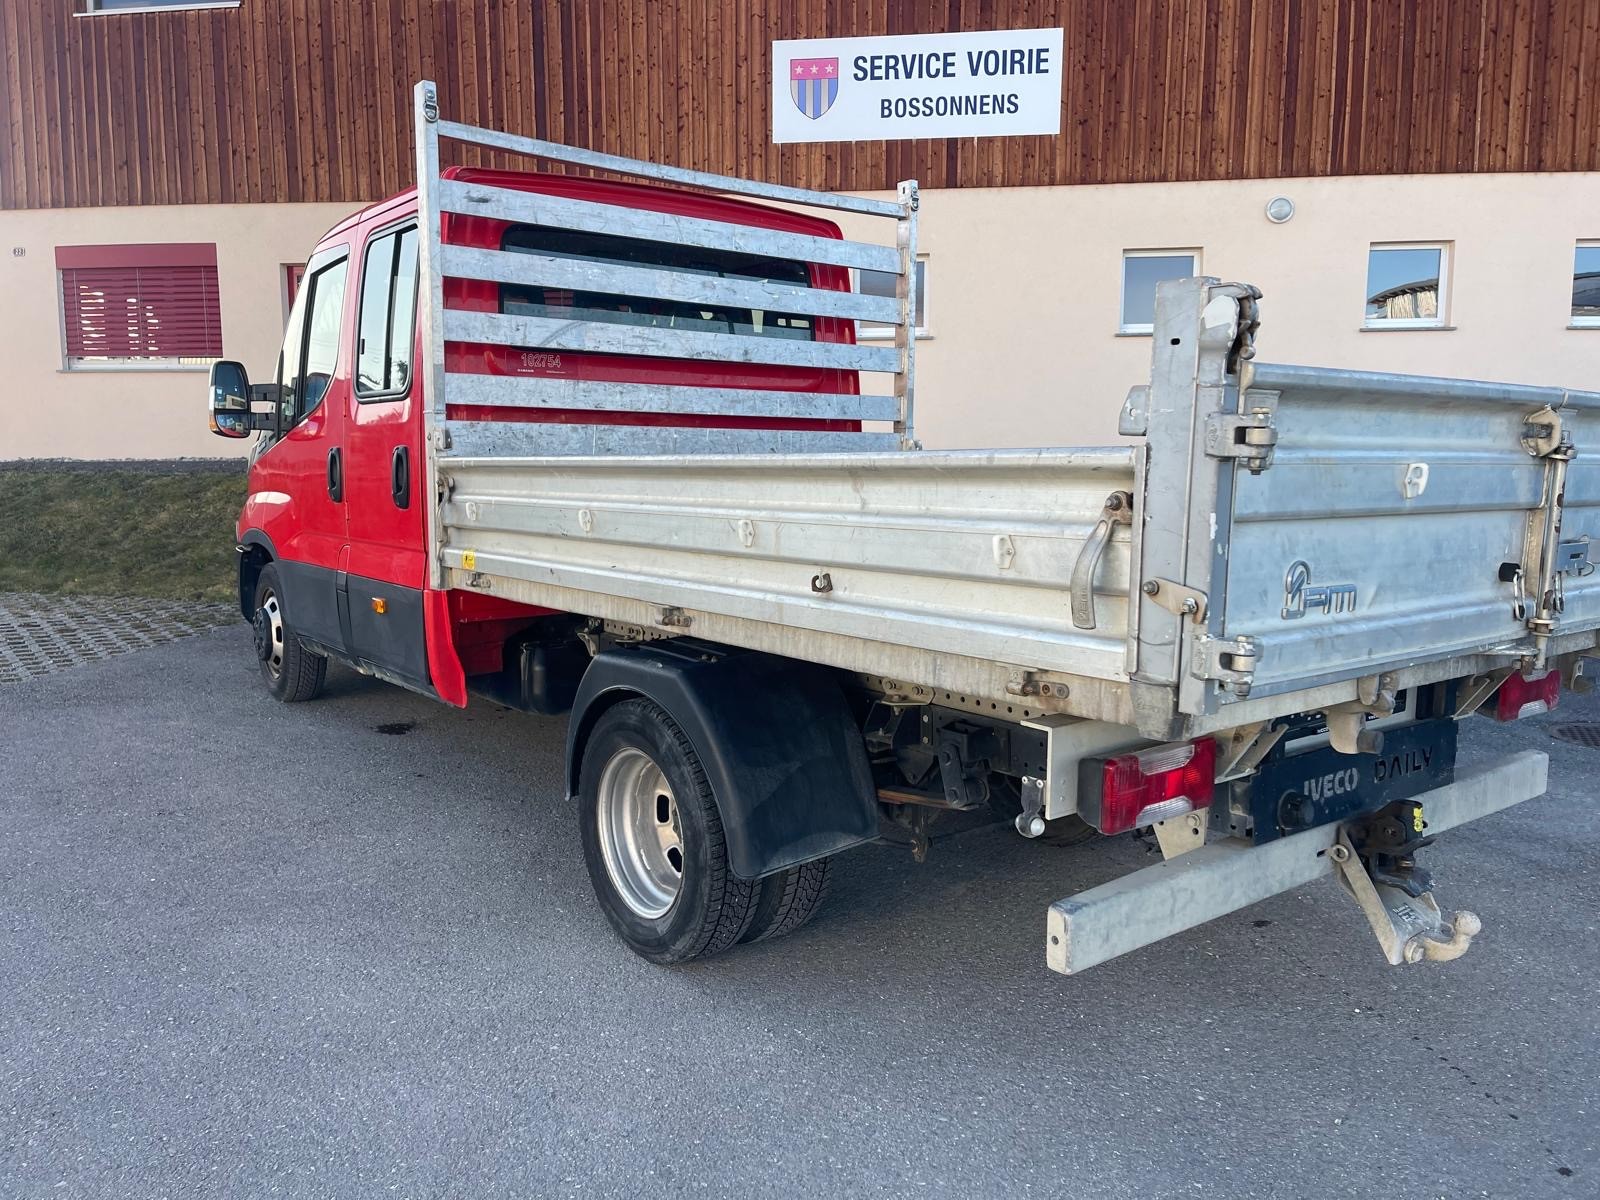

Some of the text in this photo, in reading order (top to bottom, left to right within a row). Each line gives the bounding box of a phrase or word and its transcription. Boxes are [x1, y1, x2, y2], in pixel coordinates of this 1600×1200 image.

[853, 48, 1050, 81] SERVICE VOIRIE
[880, 93, 1019, 118] BOSSONNENS
[1303, 746, 1433, 801] IVECO DAILY
